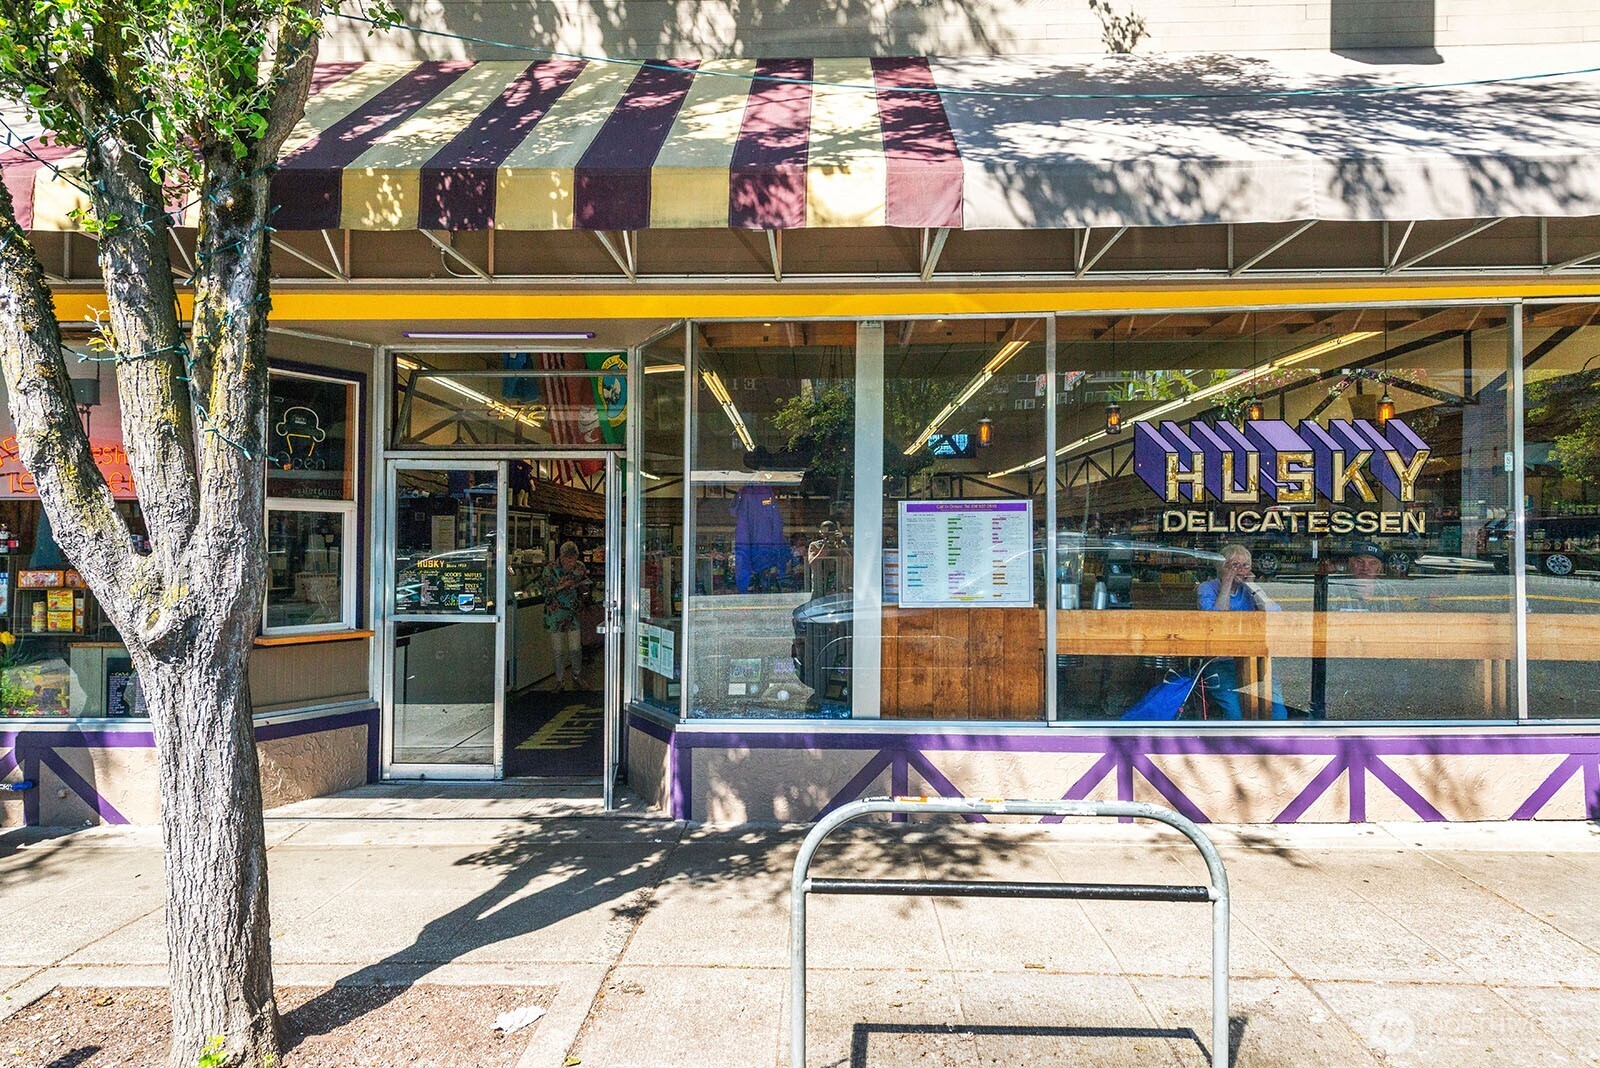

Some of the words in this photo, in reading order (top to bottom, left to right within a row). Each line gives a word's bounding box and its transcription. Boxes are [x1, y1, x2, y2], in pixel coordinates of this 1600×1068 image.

[1134, 419, 1431, 503] HUSKY
[1162, 511, 1426, 534] DELICATESSEN
[417, 560, 445, 568] HUSKY
